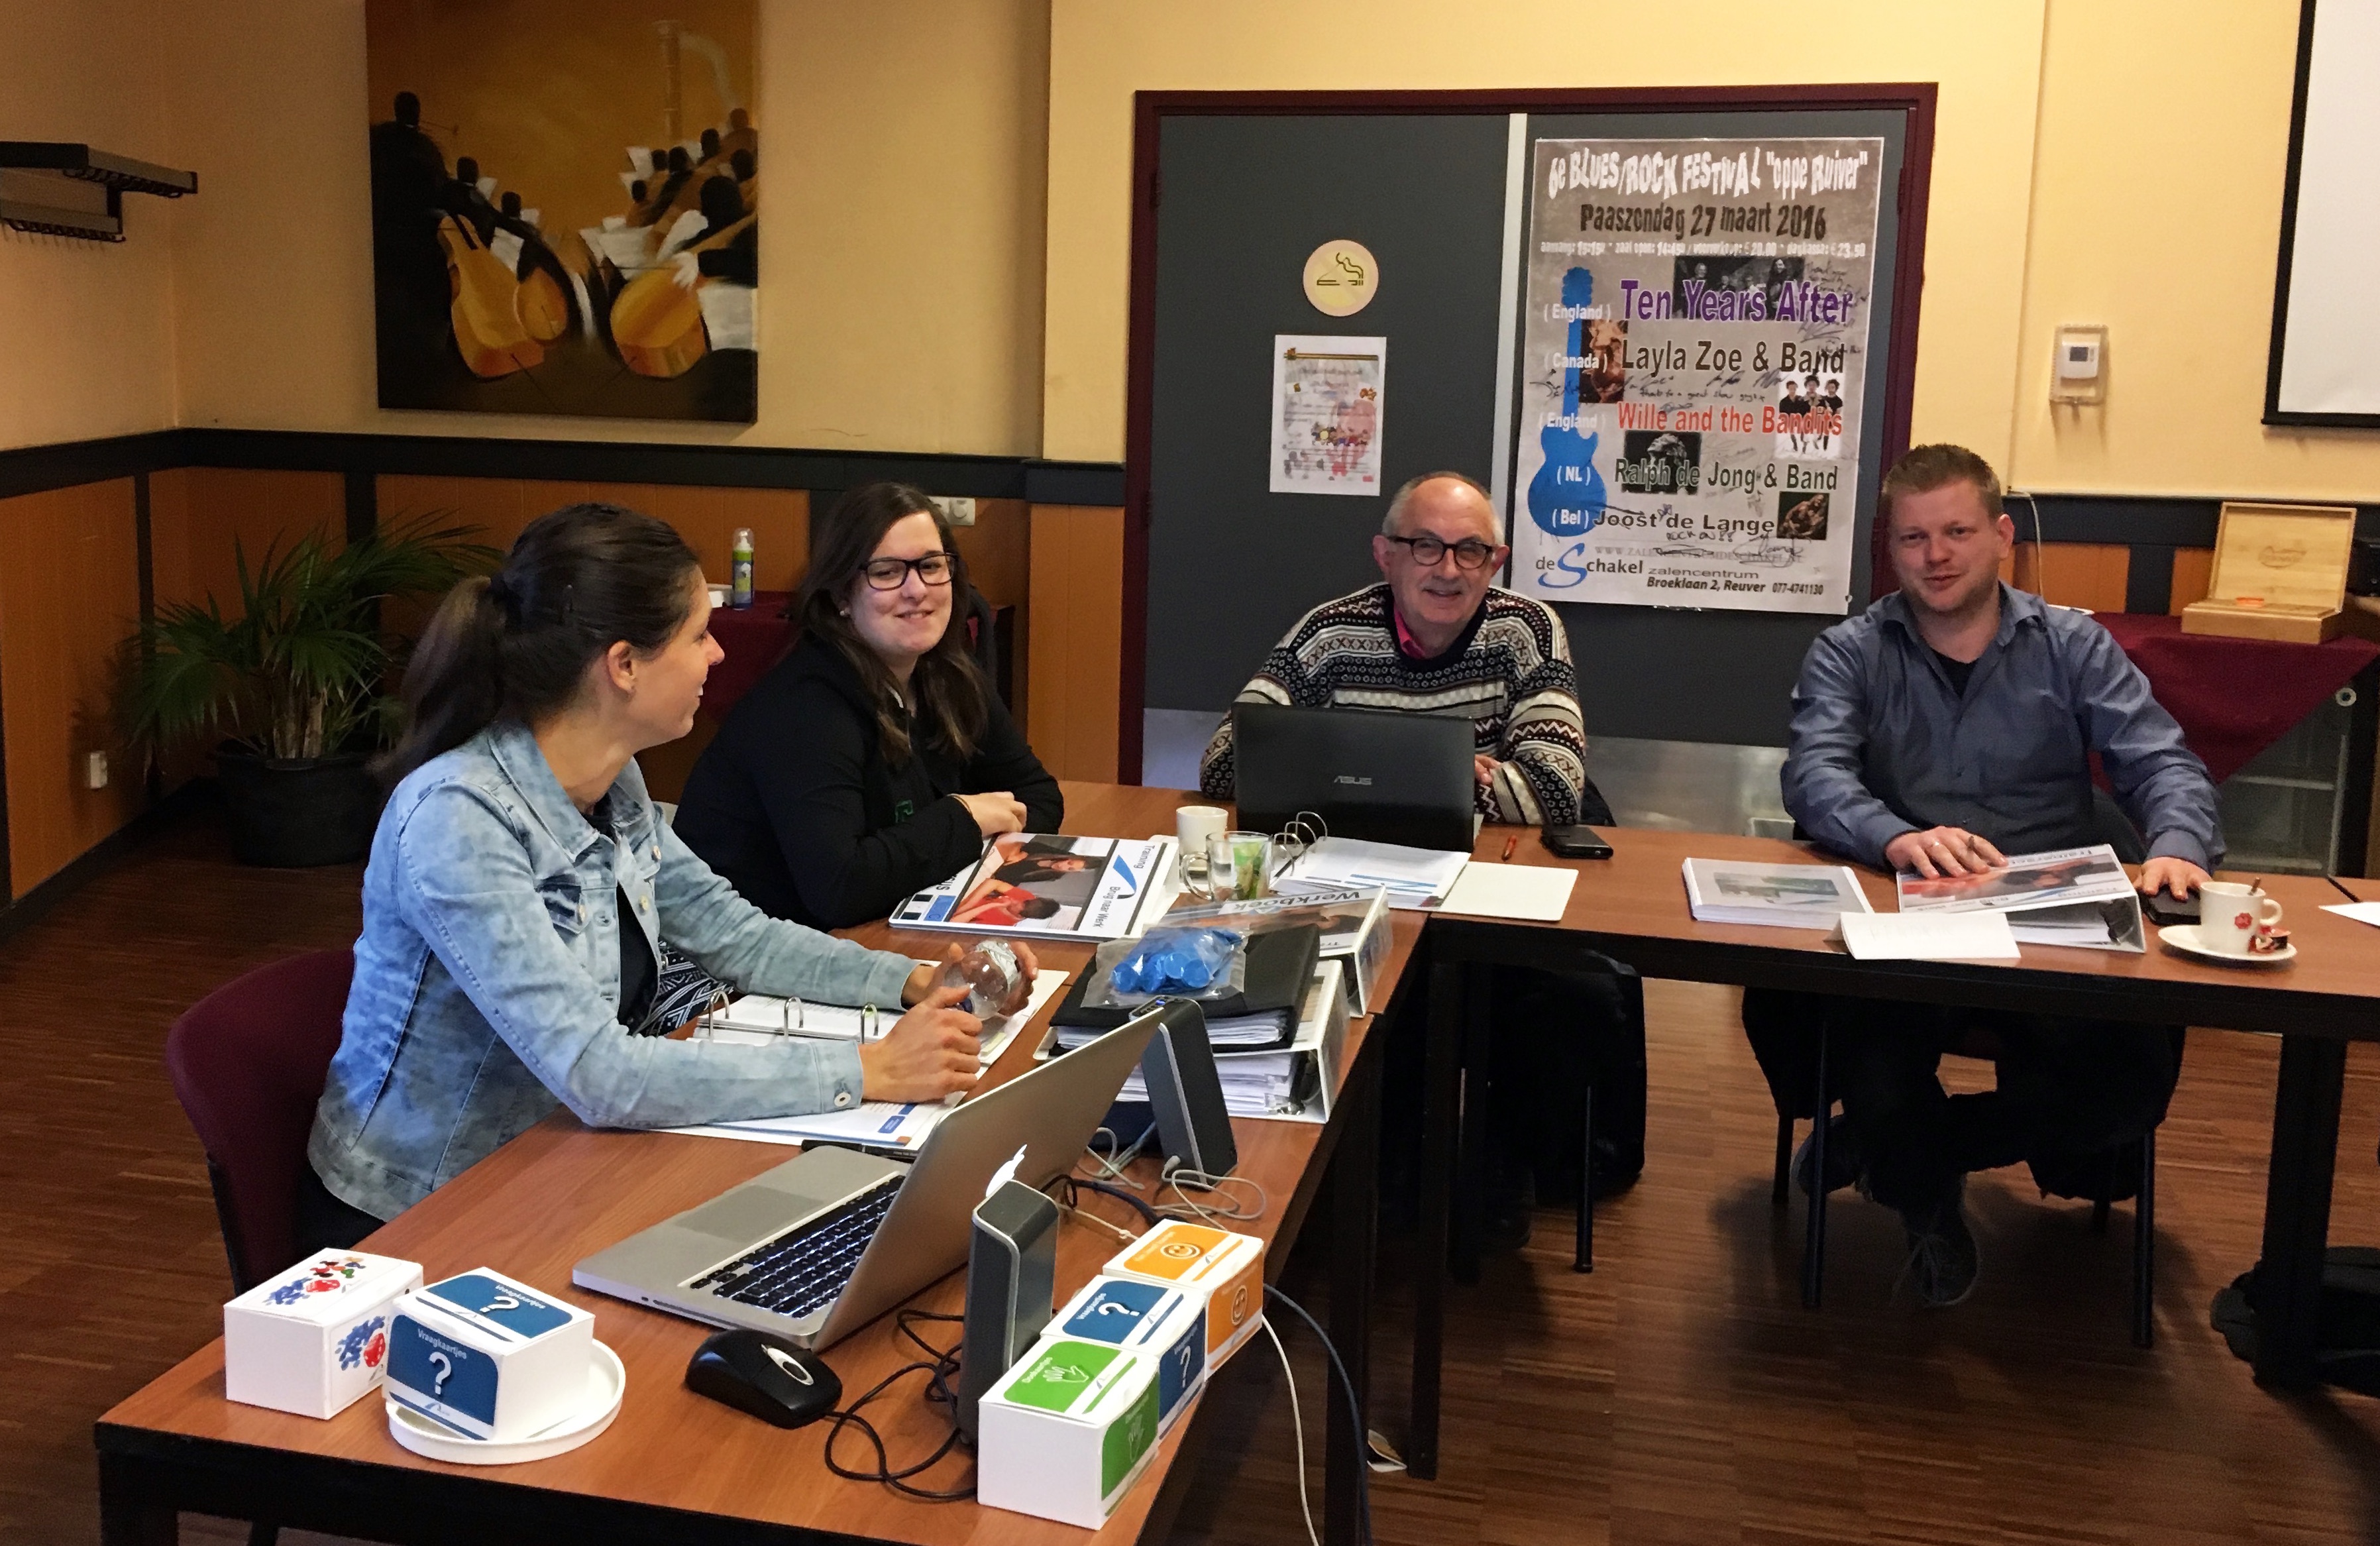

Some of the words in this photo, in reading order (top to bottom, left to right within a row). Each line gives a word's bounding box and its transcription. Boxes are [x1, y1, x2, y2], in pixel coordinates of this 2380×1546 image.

[1549, 158, 1566, 199] 6e
[1580, 202, 1685, 241] Paaszondag
[1690, 204, 1717, 237] 27
[1721, 202, 1772, 233] maart
[1776, 205, 1827, 240] 2016
[1621, 279, 1673, 321] Ten
[1682, 279, 1766, 322] Years
[1775, 280, 1853, 323] After
[1622, 340, 1686, 377] Layla
[1695, 341, 1743, 371] Zoe
[1753, 341, 1769, 372] &
[1780, 342, 1845, 374] Band
[1617, 401, 1668, 431] Wille
[1674, 405, 1713, 431] and
[1721, 406, 1754, 433] the
[1762, 406, 1842, 436] Bandits
[1615, 458, 1671, 491] Ralph
[1676, 459, 1701, 487] de
[1707, 461, 1756, 494] Jong
[1764, 463, 1778, 488] &
[1786, 464, 1838, 490] Band
[1593, 510, 1656, 528] Joost
[1666, 513, 1694, 529] de
[1703, 514, 1775, 536] Lange
[1647, 577, 1707, 590] Broeklaan
[1710, 580, 1720, 592] 2,
[1723, 580, 1766, 592] Reuver
[1772, 582, 1824, 595] 077-4741130
[1649, 567, 1759, 579] zalencentrum
[1334, 775, 1372, 785] ASUS
[1134, 846, 1155, 869] Training
[1103, 887, 1120, 899] Brug
[1234, 891, 1360, 910] Workbook
